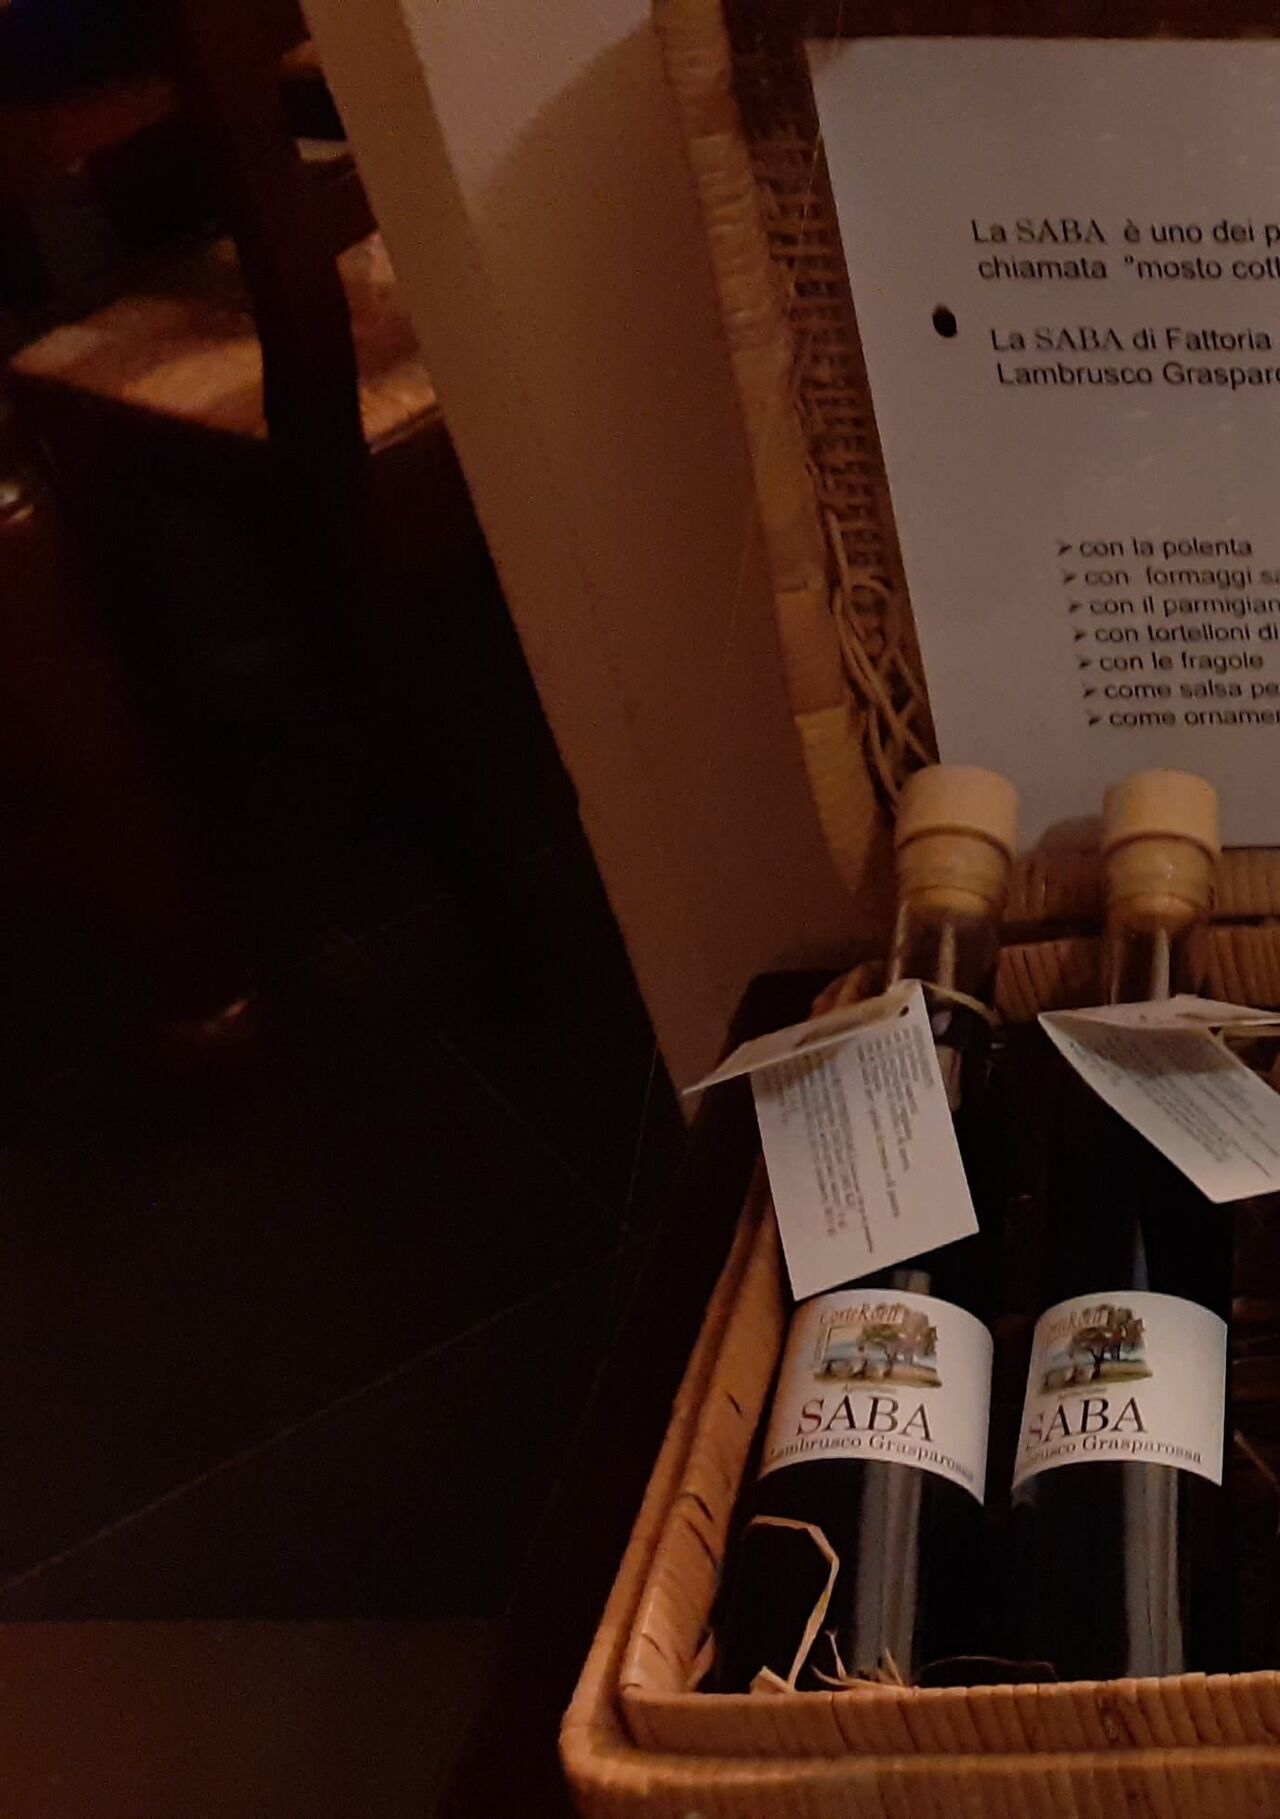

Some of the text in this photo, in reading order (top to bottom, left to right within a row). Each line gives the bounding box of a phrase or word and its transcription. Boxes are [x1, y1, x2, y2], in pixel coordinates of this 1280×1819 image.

[971, 219, 1007, 244] La
[1016, 218, 1108, 244] SABA
[1124, 218, 1141, 245] è
[1150, 224, 1202, 245] uno
[1211, 219, 1255, 245] dei
[978, 256, 1108, 280] chiamata
[1124, 255, 1223, 281] "mosto
[990, 328, 1026, 352] La
[1035, 327, 1124, 352] SABA
[1132, 328, 1157, 352] di
[1165, 327, 1272, 352] Fattoria
[997, 362, 1153, 386] Lambrusco
[1079, 536, 1253, 560] con la polenta
[1085, 570, 1131, 586] con
[1146, 565, 1252, 590] formaggi
[1090, 599, 1134, 615] con
[1143, 596, 1155, 614] il
[1095, 628, 1139, 643] con
[1147, 623, 1250, 643] tortelloni
[1258, 623, 1278, 642] di
[1100, 651, 1264, 674] con le fragole
[1104, 684, 1171, 699] come
[1180, 679, 1242, 698] salsa
[1109, 712, 1176, 729] come
[796, 1394, 934, 1443] SABA
[1082, 1433, 1203, 1465] Grasparossa
